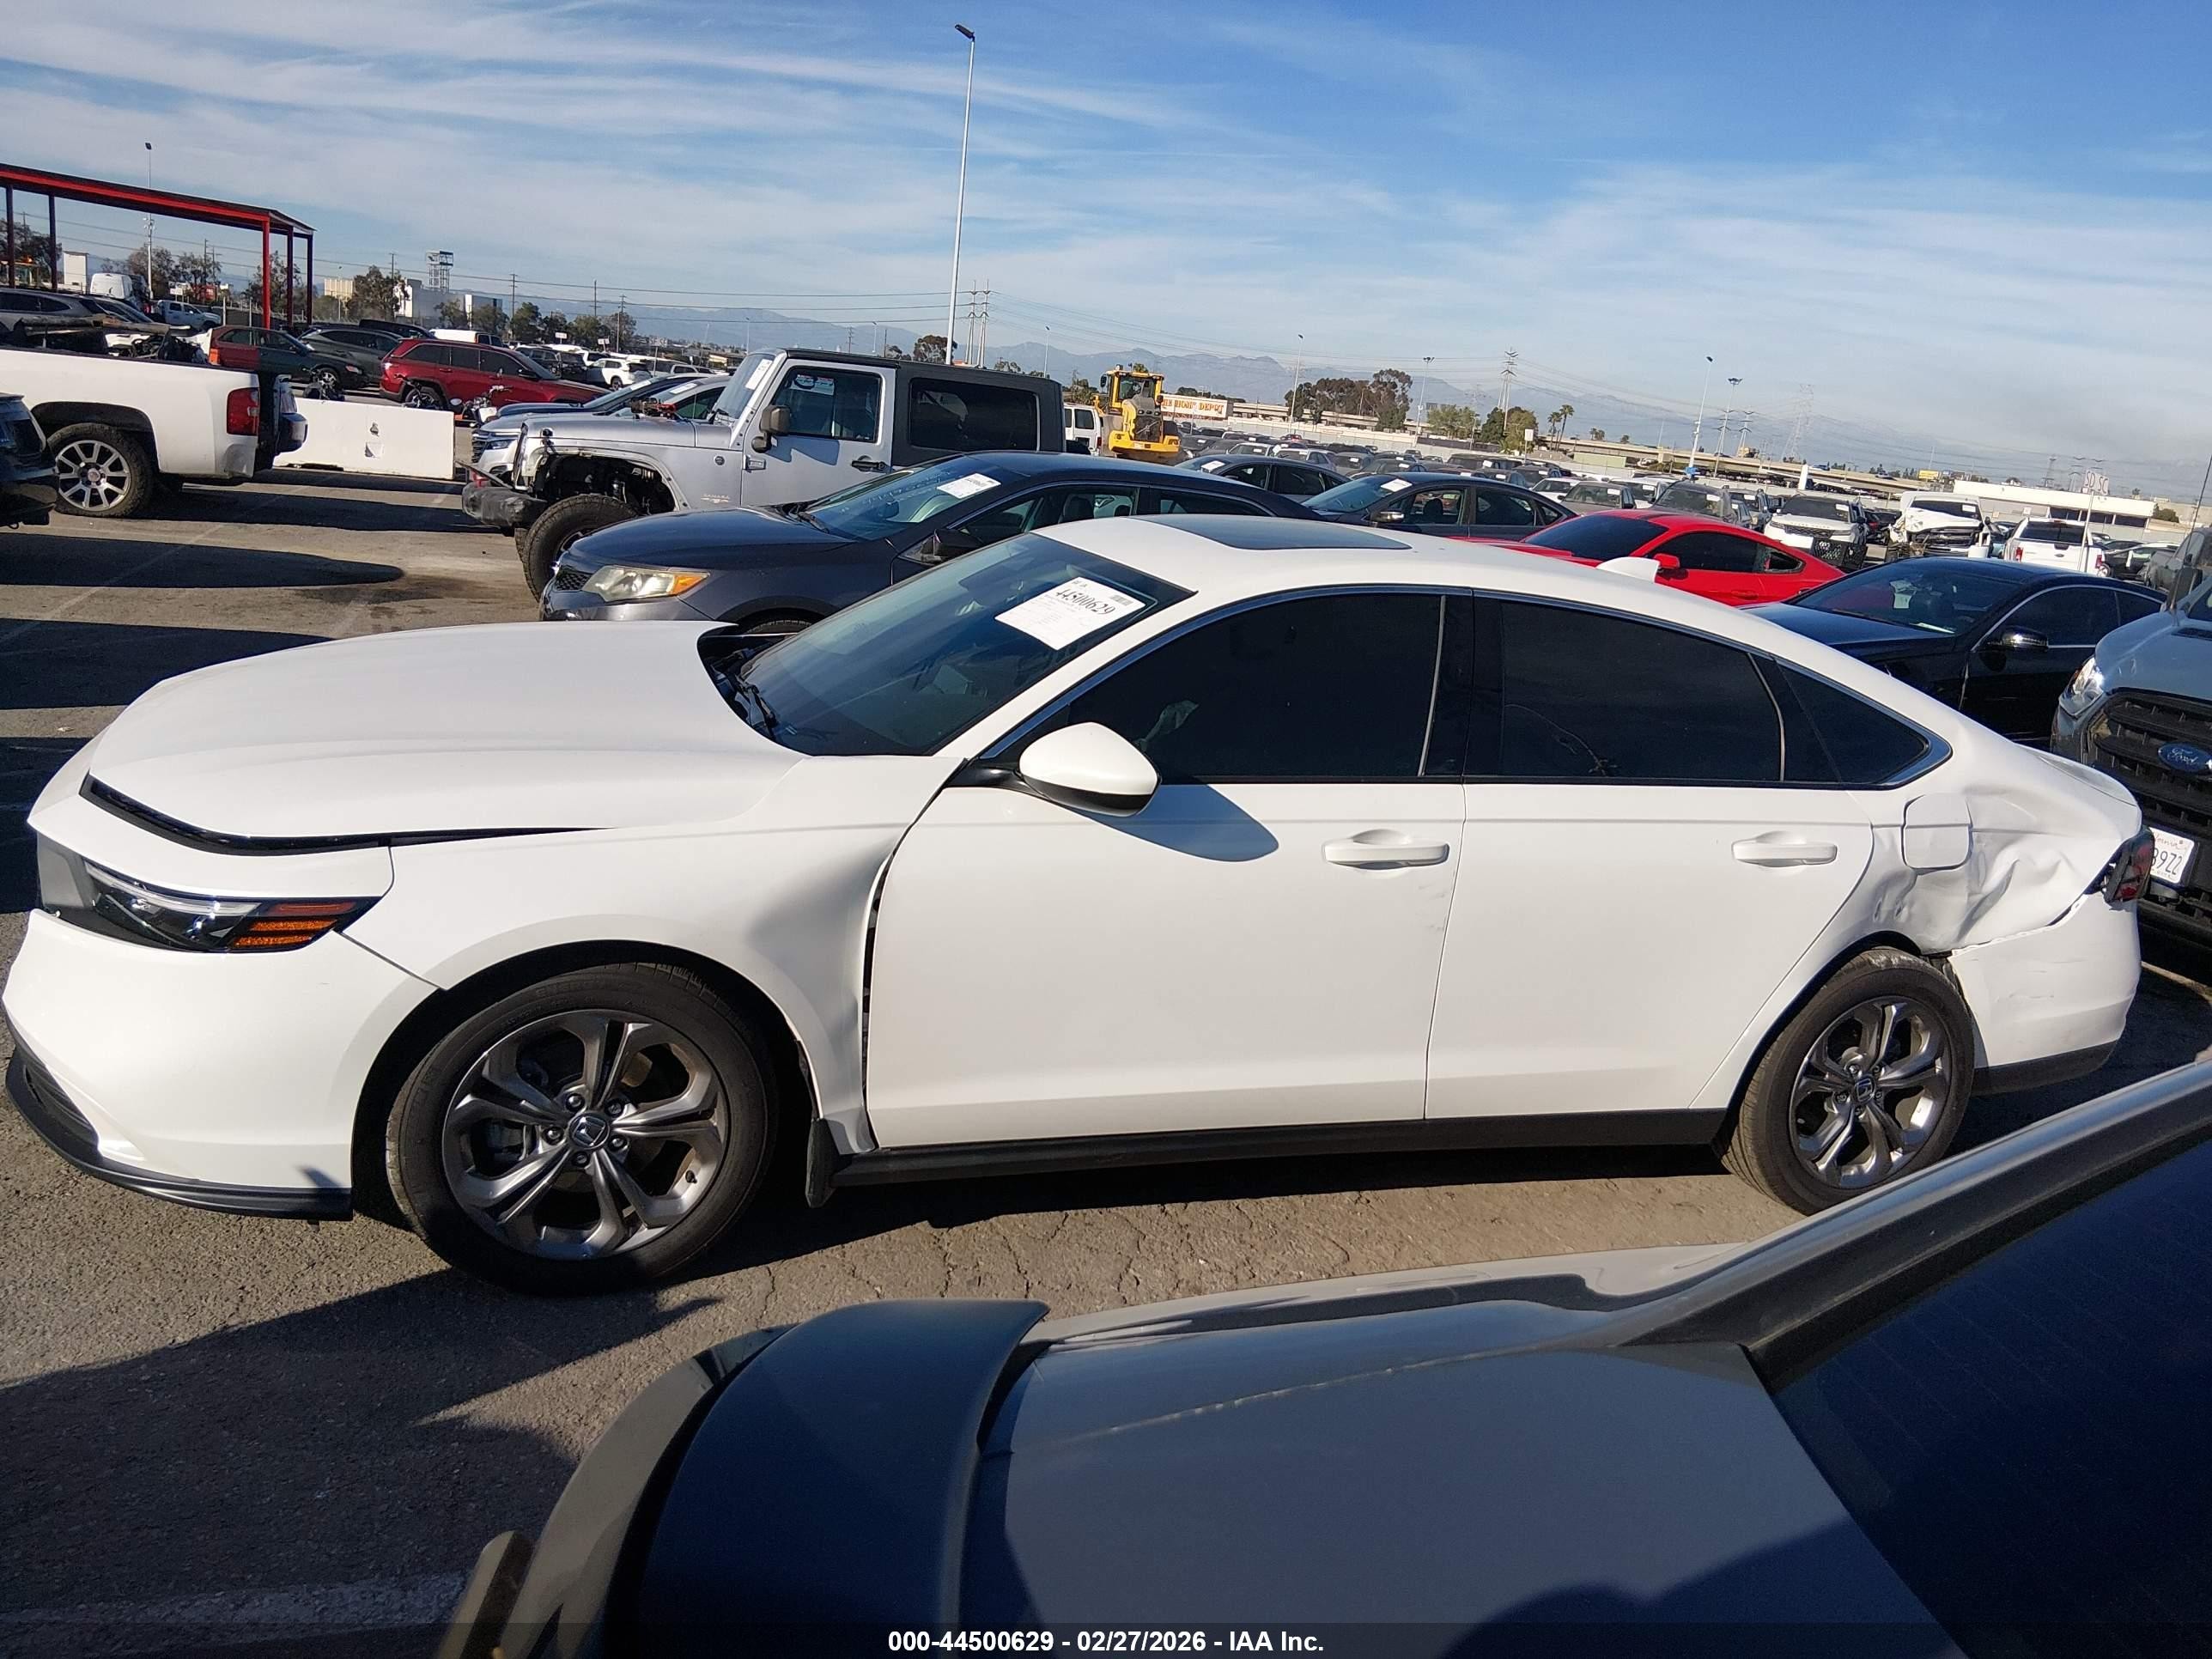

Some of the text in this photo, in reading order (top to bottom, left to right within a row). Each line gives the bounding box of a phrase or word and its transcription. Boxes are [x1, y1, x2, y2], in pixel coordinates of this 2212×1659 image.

[1199, 402, 1224, 414] DEPOT
[2085, 471, 2108, 495] SD SC
[1056, 588, 1115, 615] 44500629
